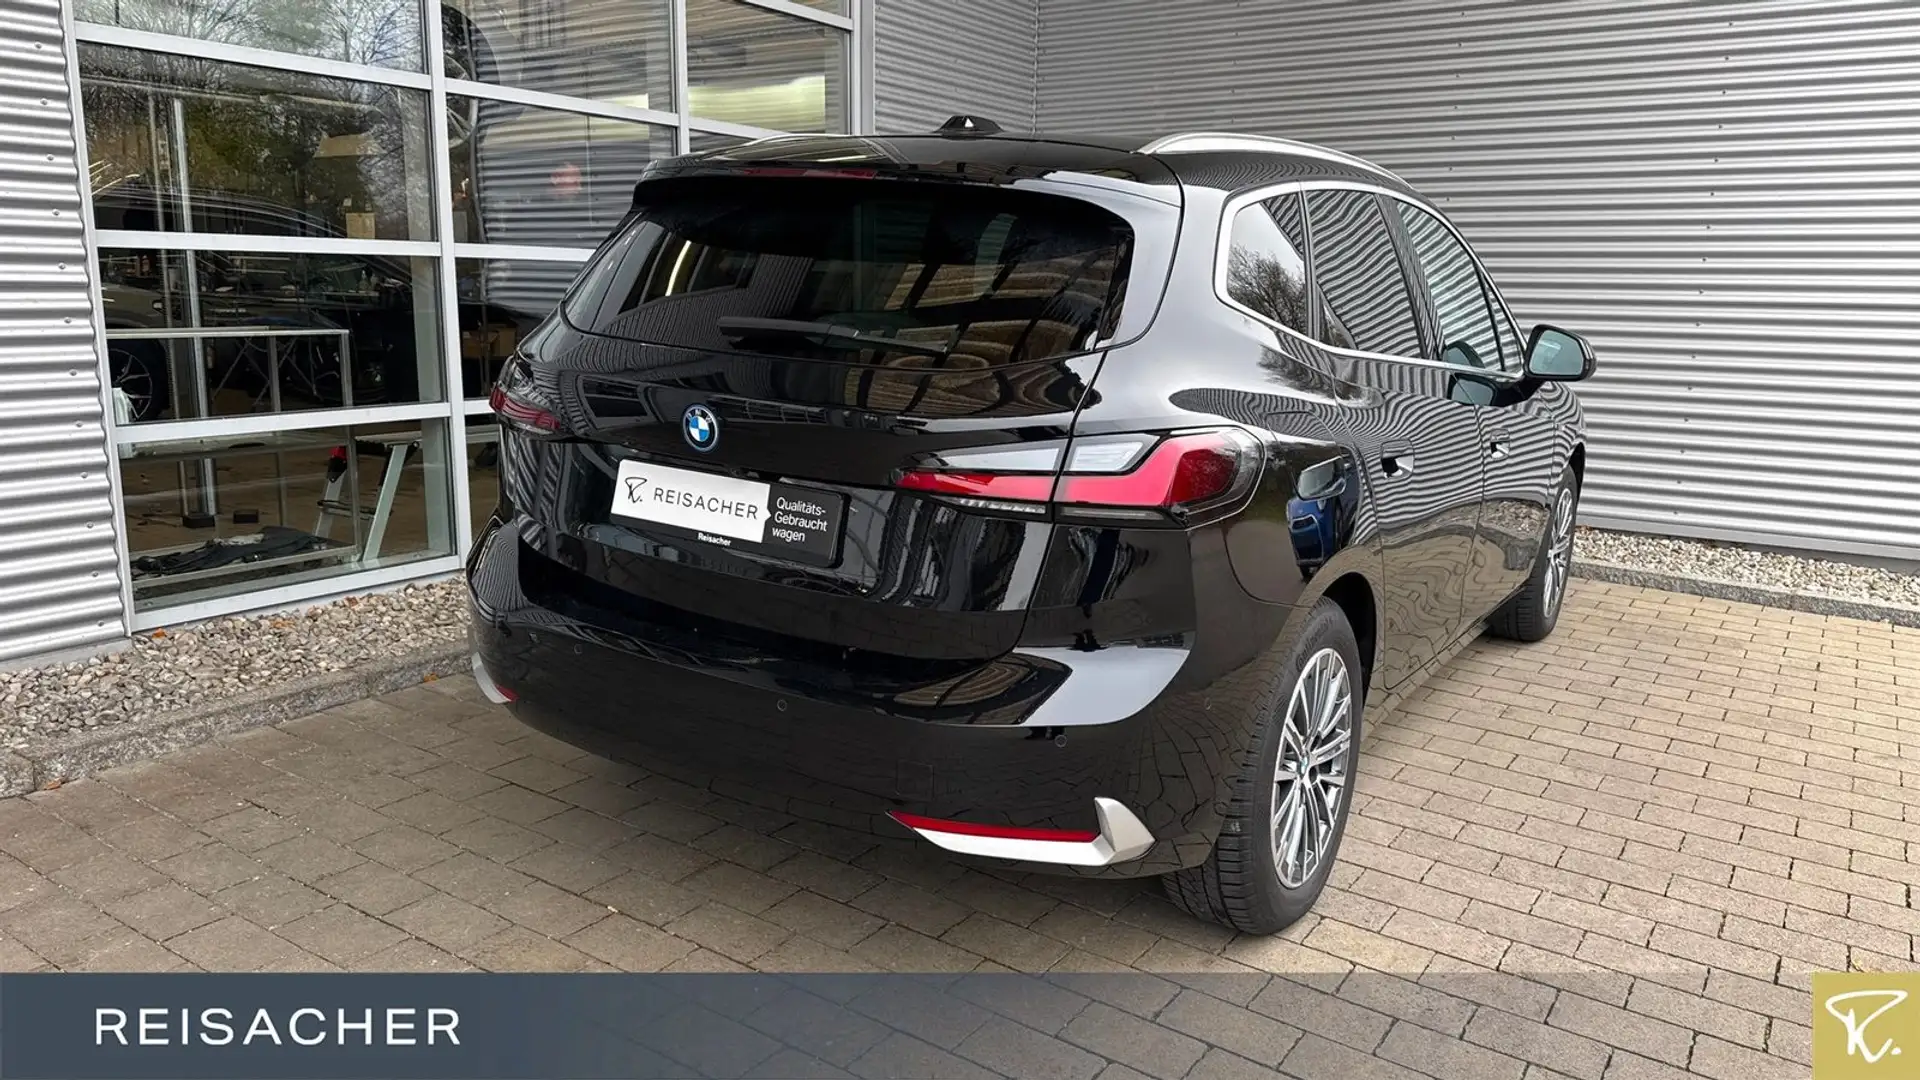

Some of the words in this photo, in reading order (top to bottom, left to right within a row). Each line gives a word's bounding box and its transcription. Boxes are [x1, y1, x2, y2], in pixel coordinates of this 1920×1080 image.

[653, 487, 759, 520] REISACHER
[776, 496, 827, 516] Qualitäts-
[774, 511, 828, 532] Gebraucht
[697, 532, 732, 546] Reisacher
[772, 527, 806, 543] wagen
